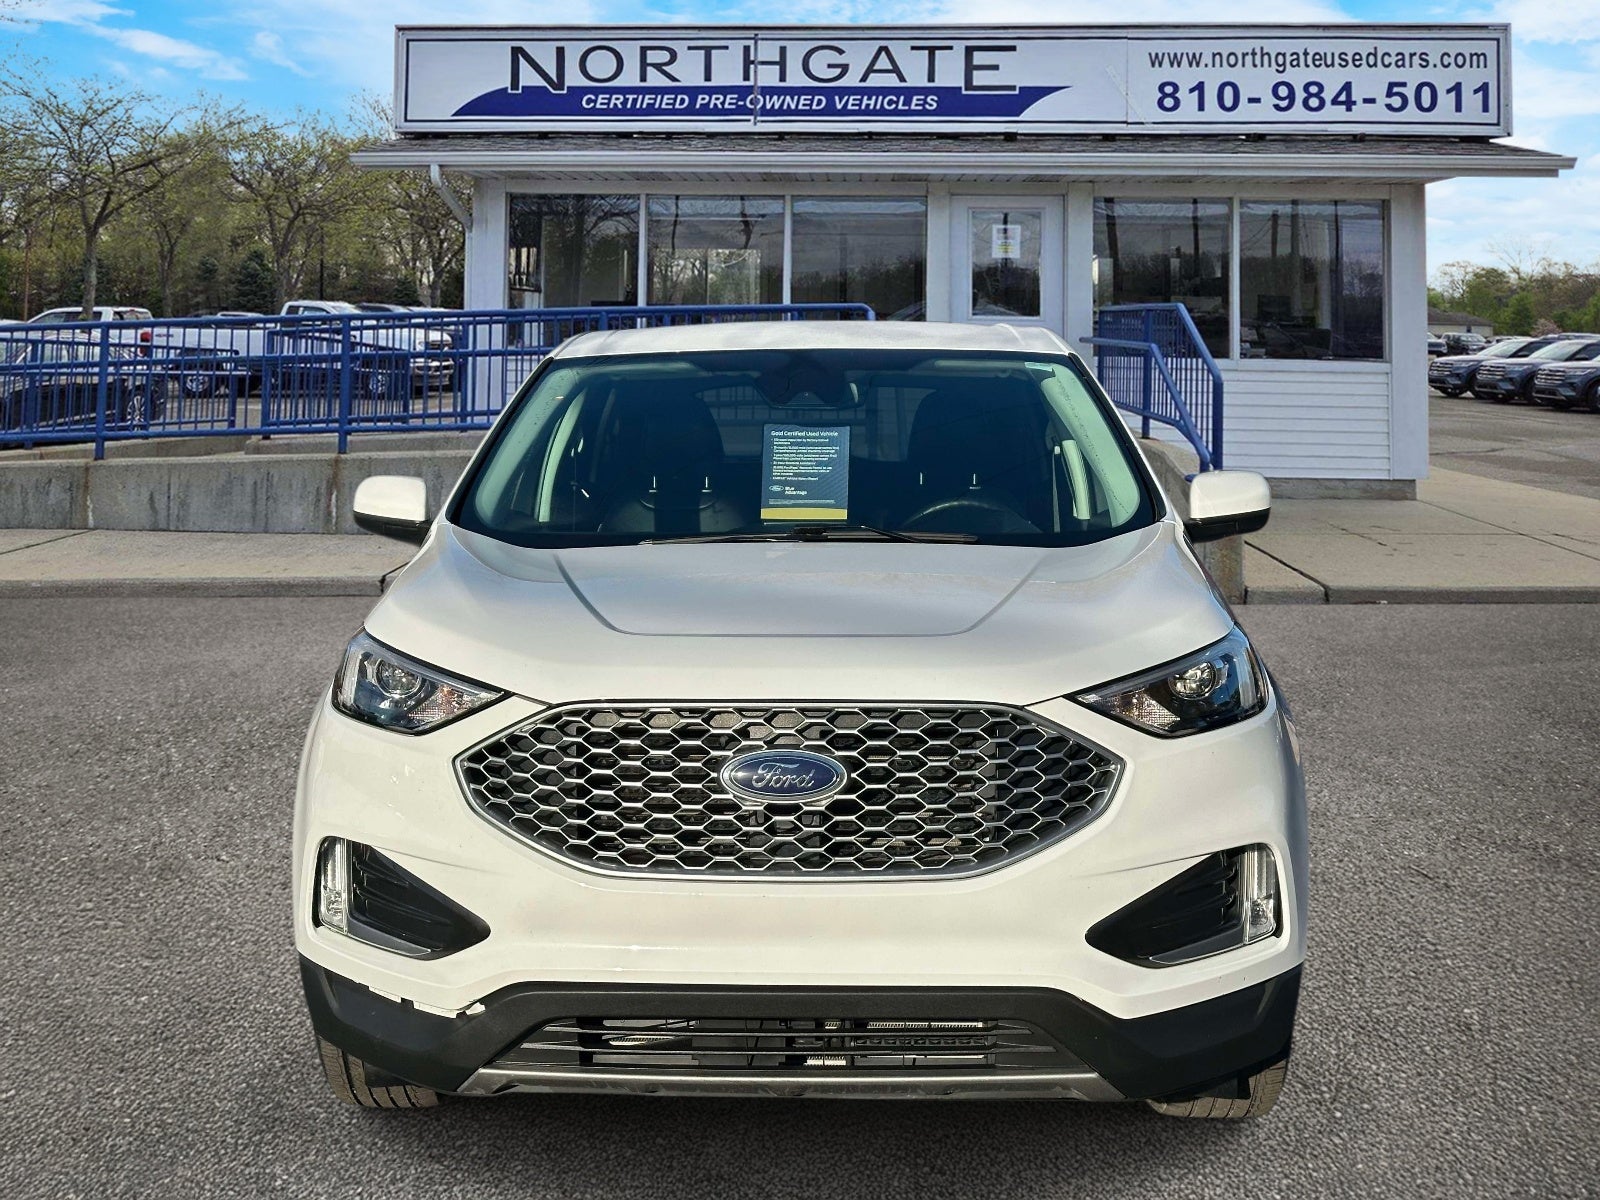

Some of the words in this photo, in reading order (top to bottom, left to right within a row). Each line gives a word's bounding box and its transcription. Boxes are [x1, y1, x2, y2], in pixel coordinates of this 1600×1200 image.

[509, 45, 1017, 92] NORTHGATE
[1148, 46, 1488, 74] www.northgateusedcars.com
[581, 94, 689, 109] CERTIFIED
[695, 94, 827, 110] PRE-OWNED
[834, 95, 938, 110] VEHICLES
[1156, 80, 1491, 114] 810-984-5011
[752, 762, 815, 788] Ford
